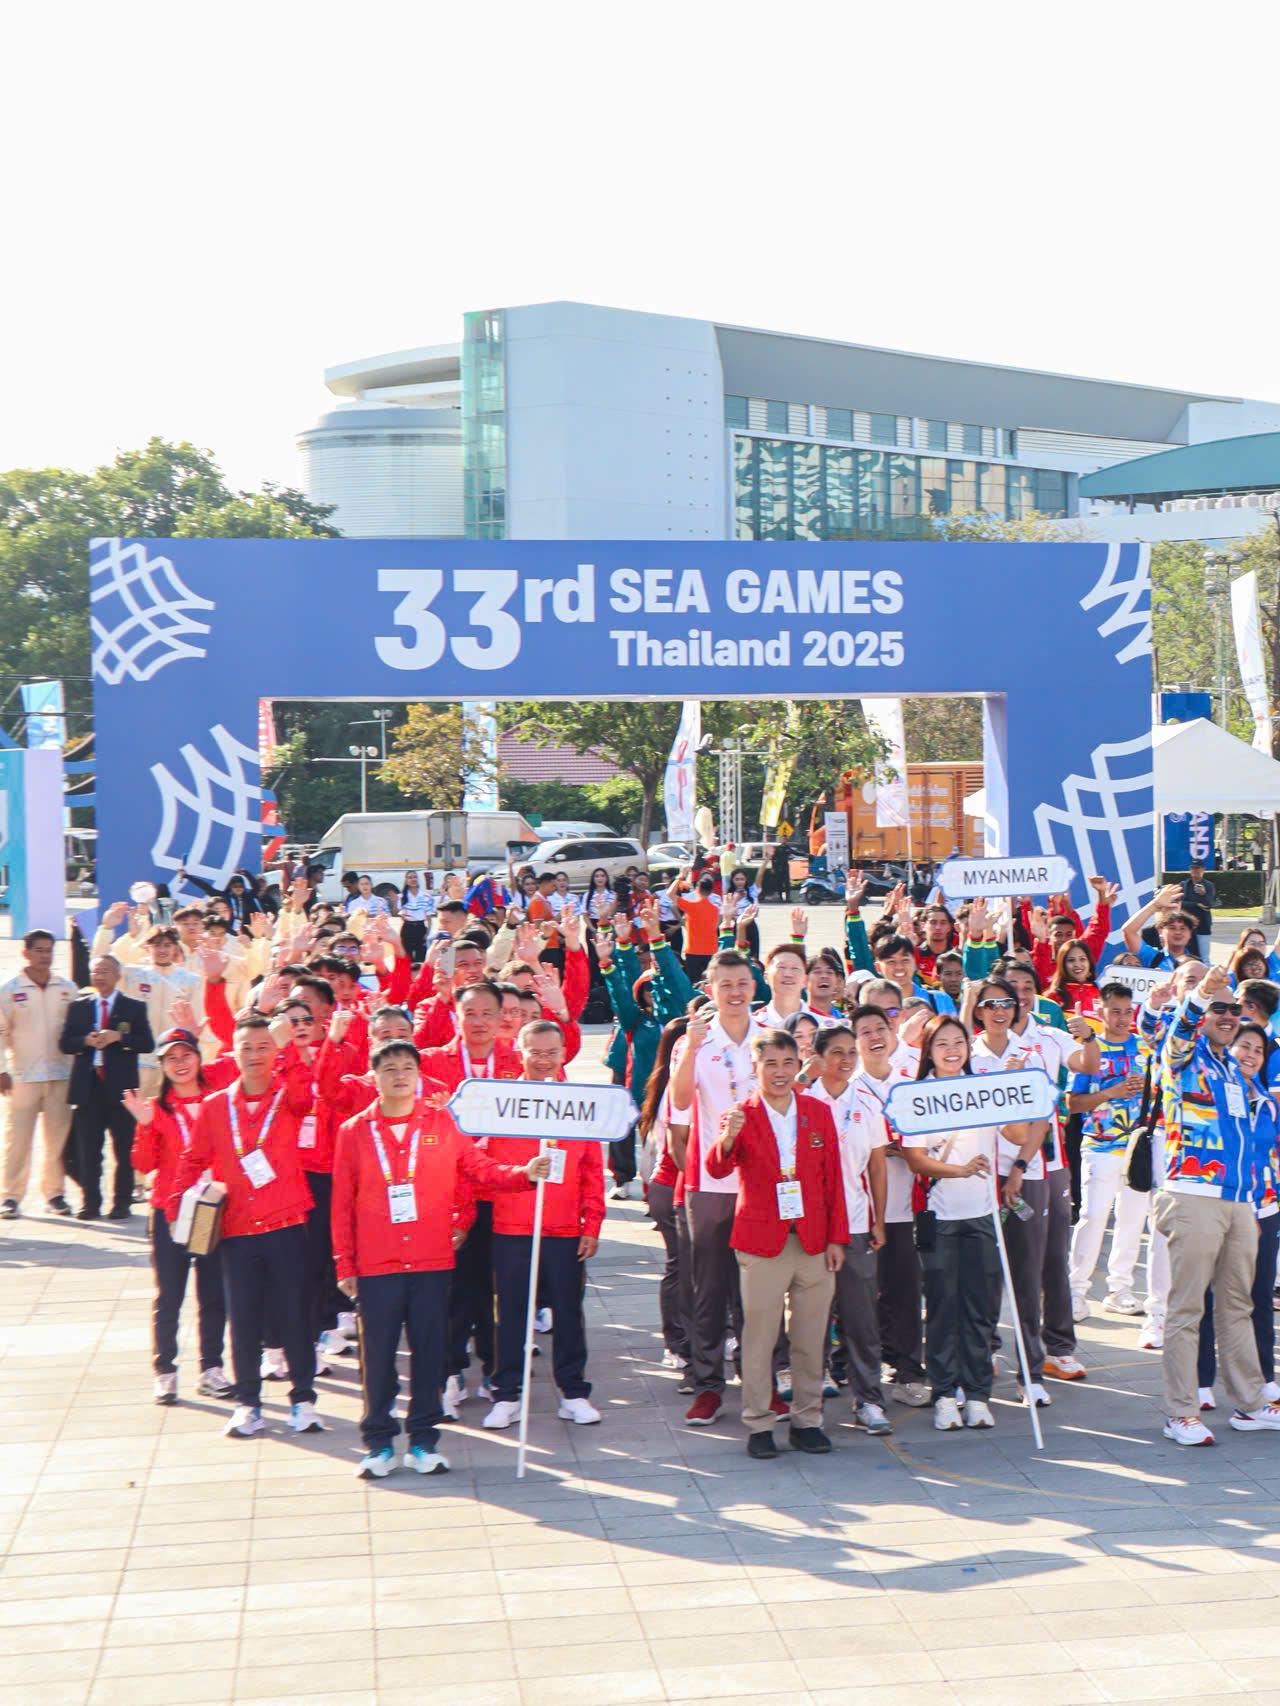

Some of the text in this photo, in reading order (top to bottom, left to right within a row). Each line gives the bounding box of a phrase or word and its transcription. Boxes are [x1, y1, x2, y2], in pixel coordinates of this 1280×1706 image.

[609, 568, 904, 614] SEA GAMES
[374, 564, 595, 671] 33rd
[609, 629, 904, 667] Thailand 2025
[962, 866, 1050, 886] MYANMAR
[496, 1097, 596, 1122] VIETNAM
[912, 1085, 1034, 1116] SINGAPORE
